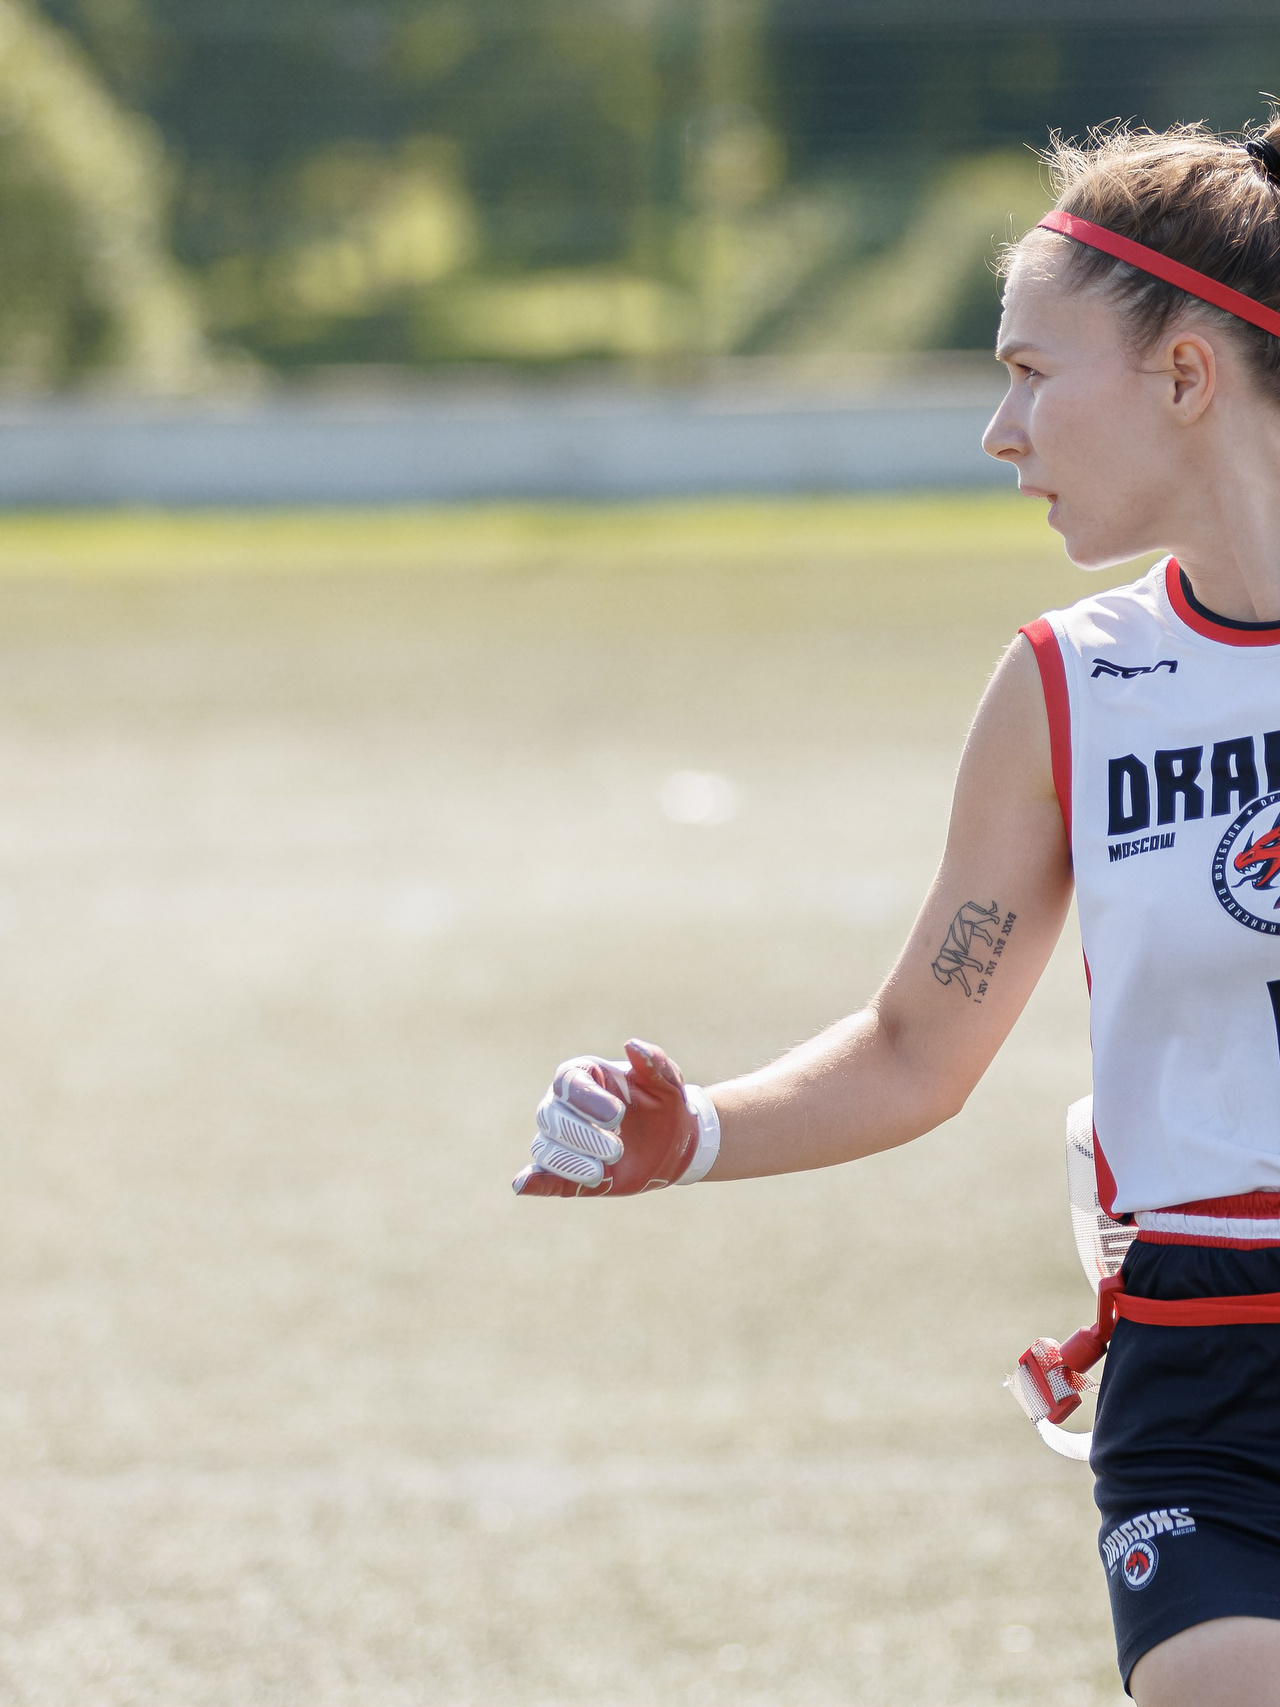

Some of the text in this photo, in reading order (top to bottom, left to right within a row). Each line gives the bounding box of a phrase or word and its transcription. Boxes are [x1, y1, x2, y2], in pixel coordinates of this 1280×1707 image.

[1109, 832, 1175, 862] MOSCOW
[1215, 823, 1241, 880] ФУТБОЛА
[1102, 1507, 1195, 1569] DRAGONS
